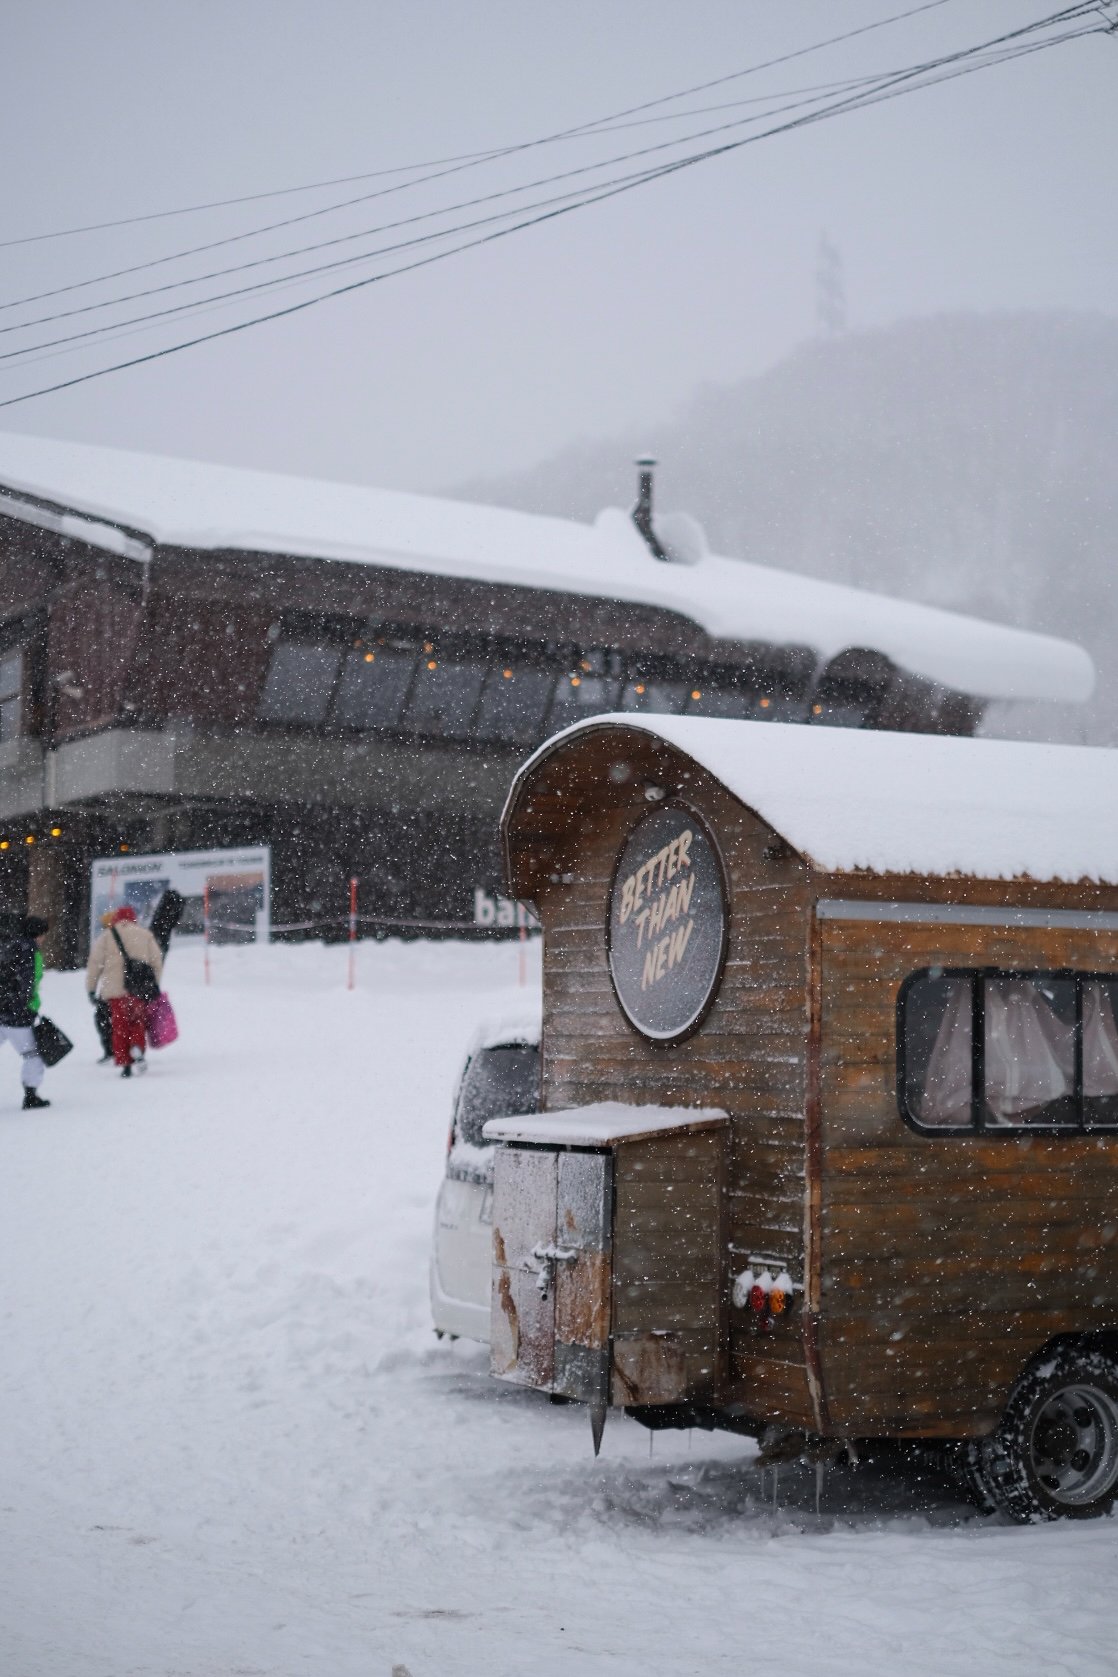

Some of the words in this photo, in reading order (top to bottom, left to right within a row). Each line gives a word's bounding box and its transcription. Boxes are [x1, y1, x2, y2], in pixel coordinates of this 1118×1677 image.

[619, 829, 693, 925] BETTER
[635, 872, 695, 951] THAN
[641, 918, 694, 991] NEW
